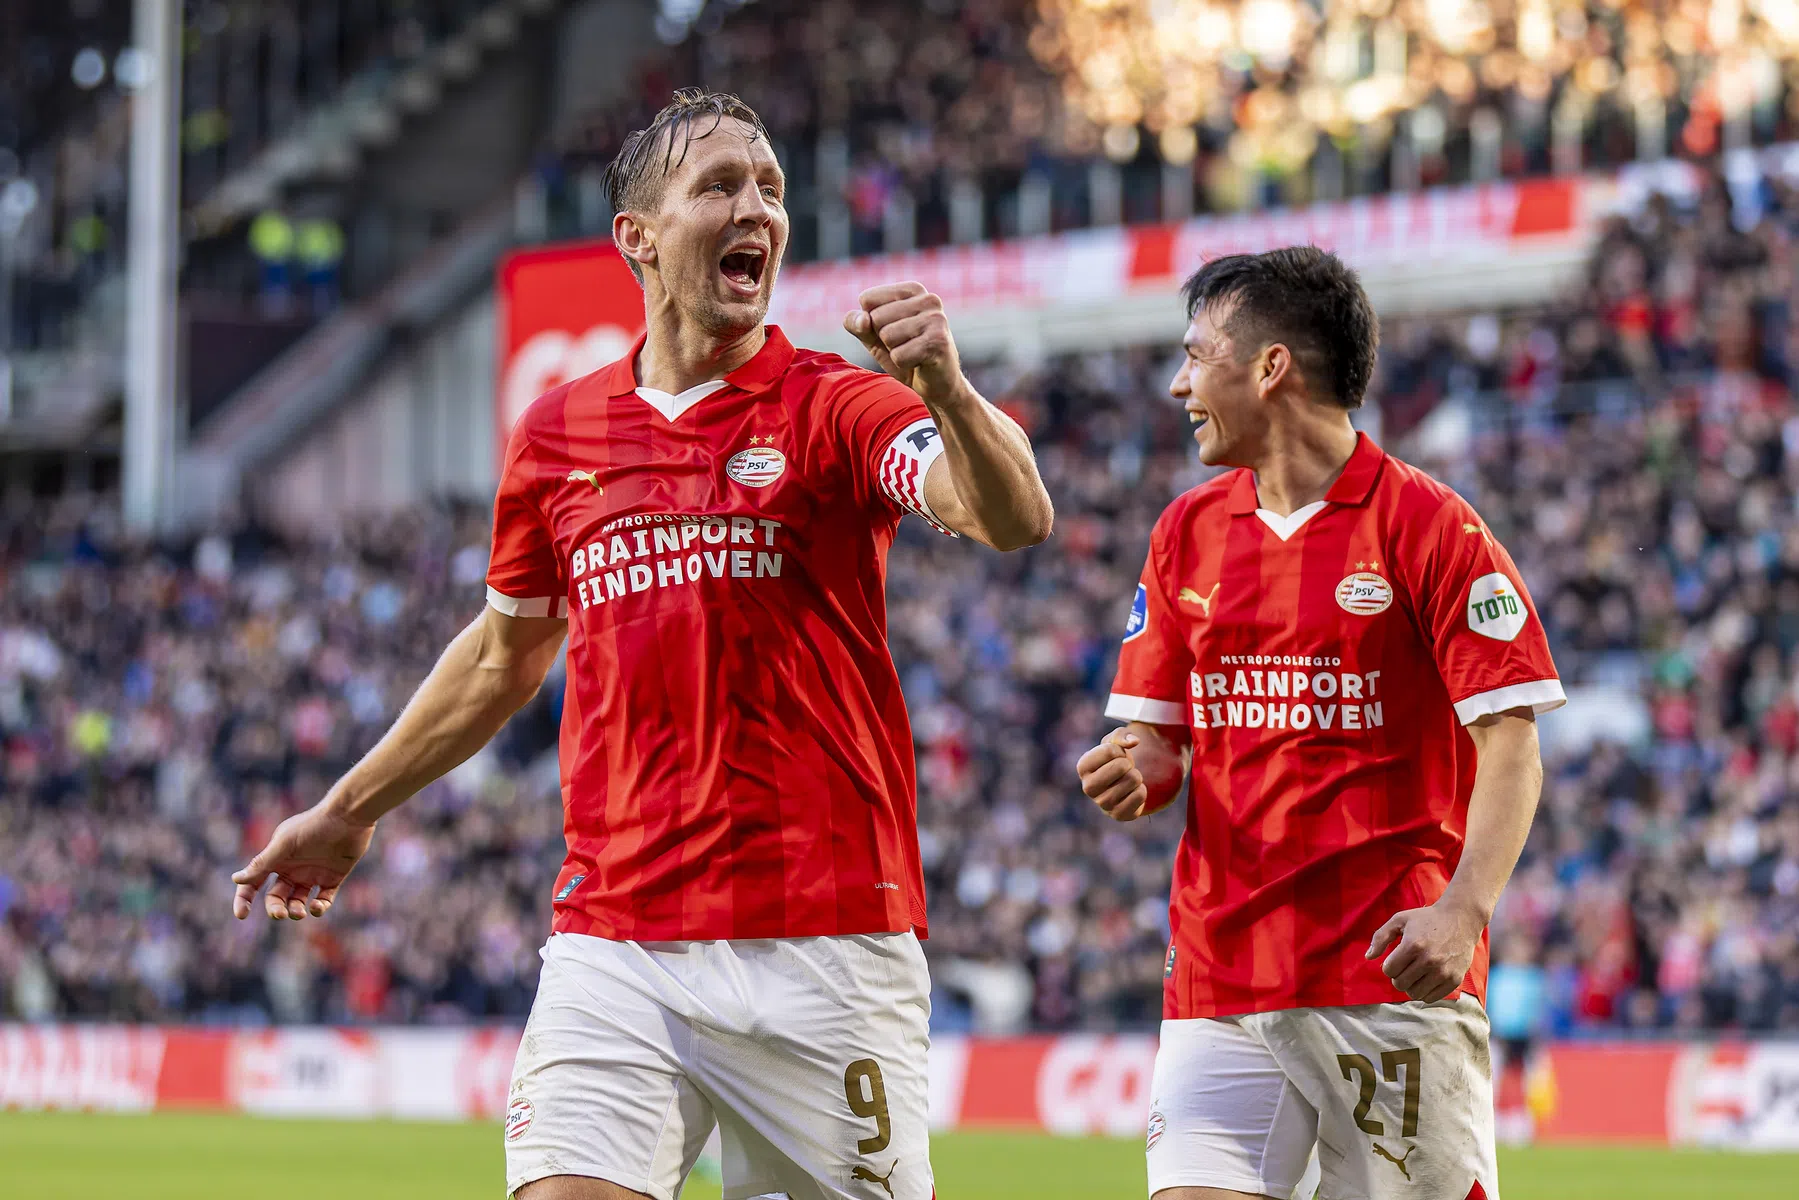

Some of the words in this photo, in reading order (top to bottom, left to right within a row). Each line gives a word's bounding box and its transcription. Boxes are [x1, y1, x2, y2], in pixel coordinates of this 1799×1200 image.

[747, 462, 768, 470] PSV
[601, 514, 717, 534] METROPOOLREG
[572, 516, 782, 579] BRAINPORT
[577, 550, 783, 611] EINDHOVEN
[1354, 587, 1375, 596] PSV
[1471, 595, 1519, 624] TOTO
[1220, 655, 1341, 667] METROPOOLREGIO
[1190, 670, 1381, 699] BRAINPORT
[1192, 701, 1384, 730] EINDHOVEN
[844, 1058, 892, 1155] 9
[1336, 1047, 1421, 1138] 27
[510, 1111, 523, 1125] PSV
